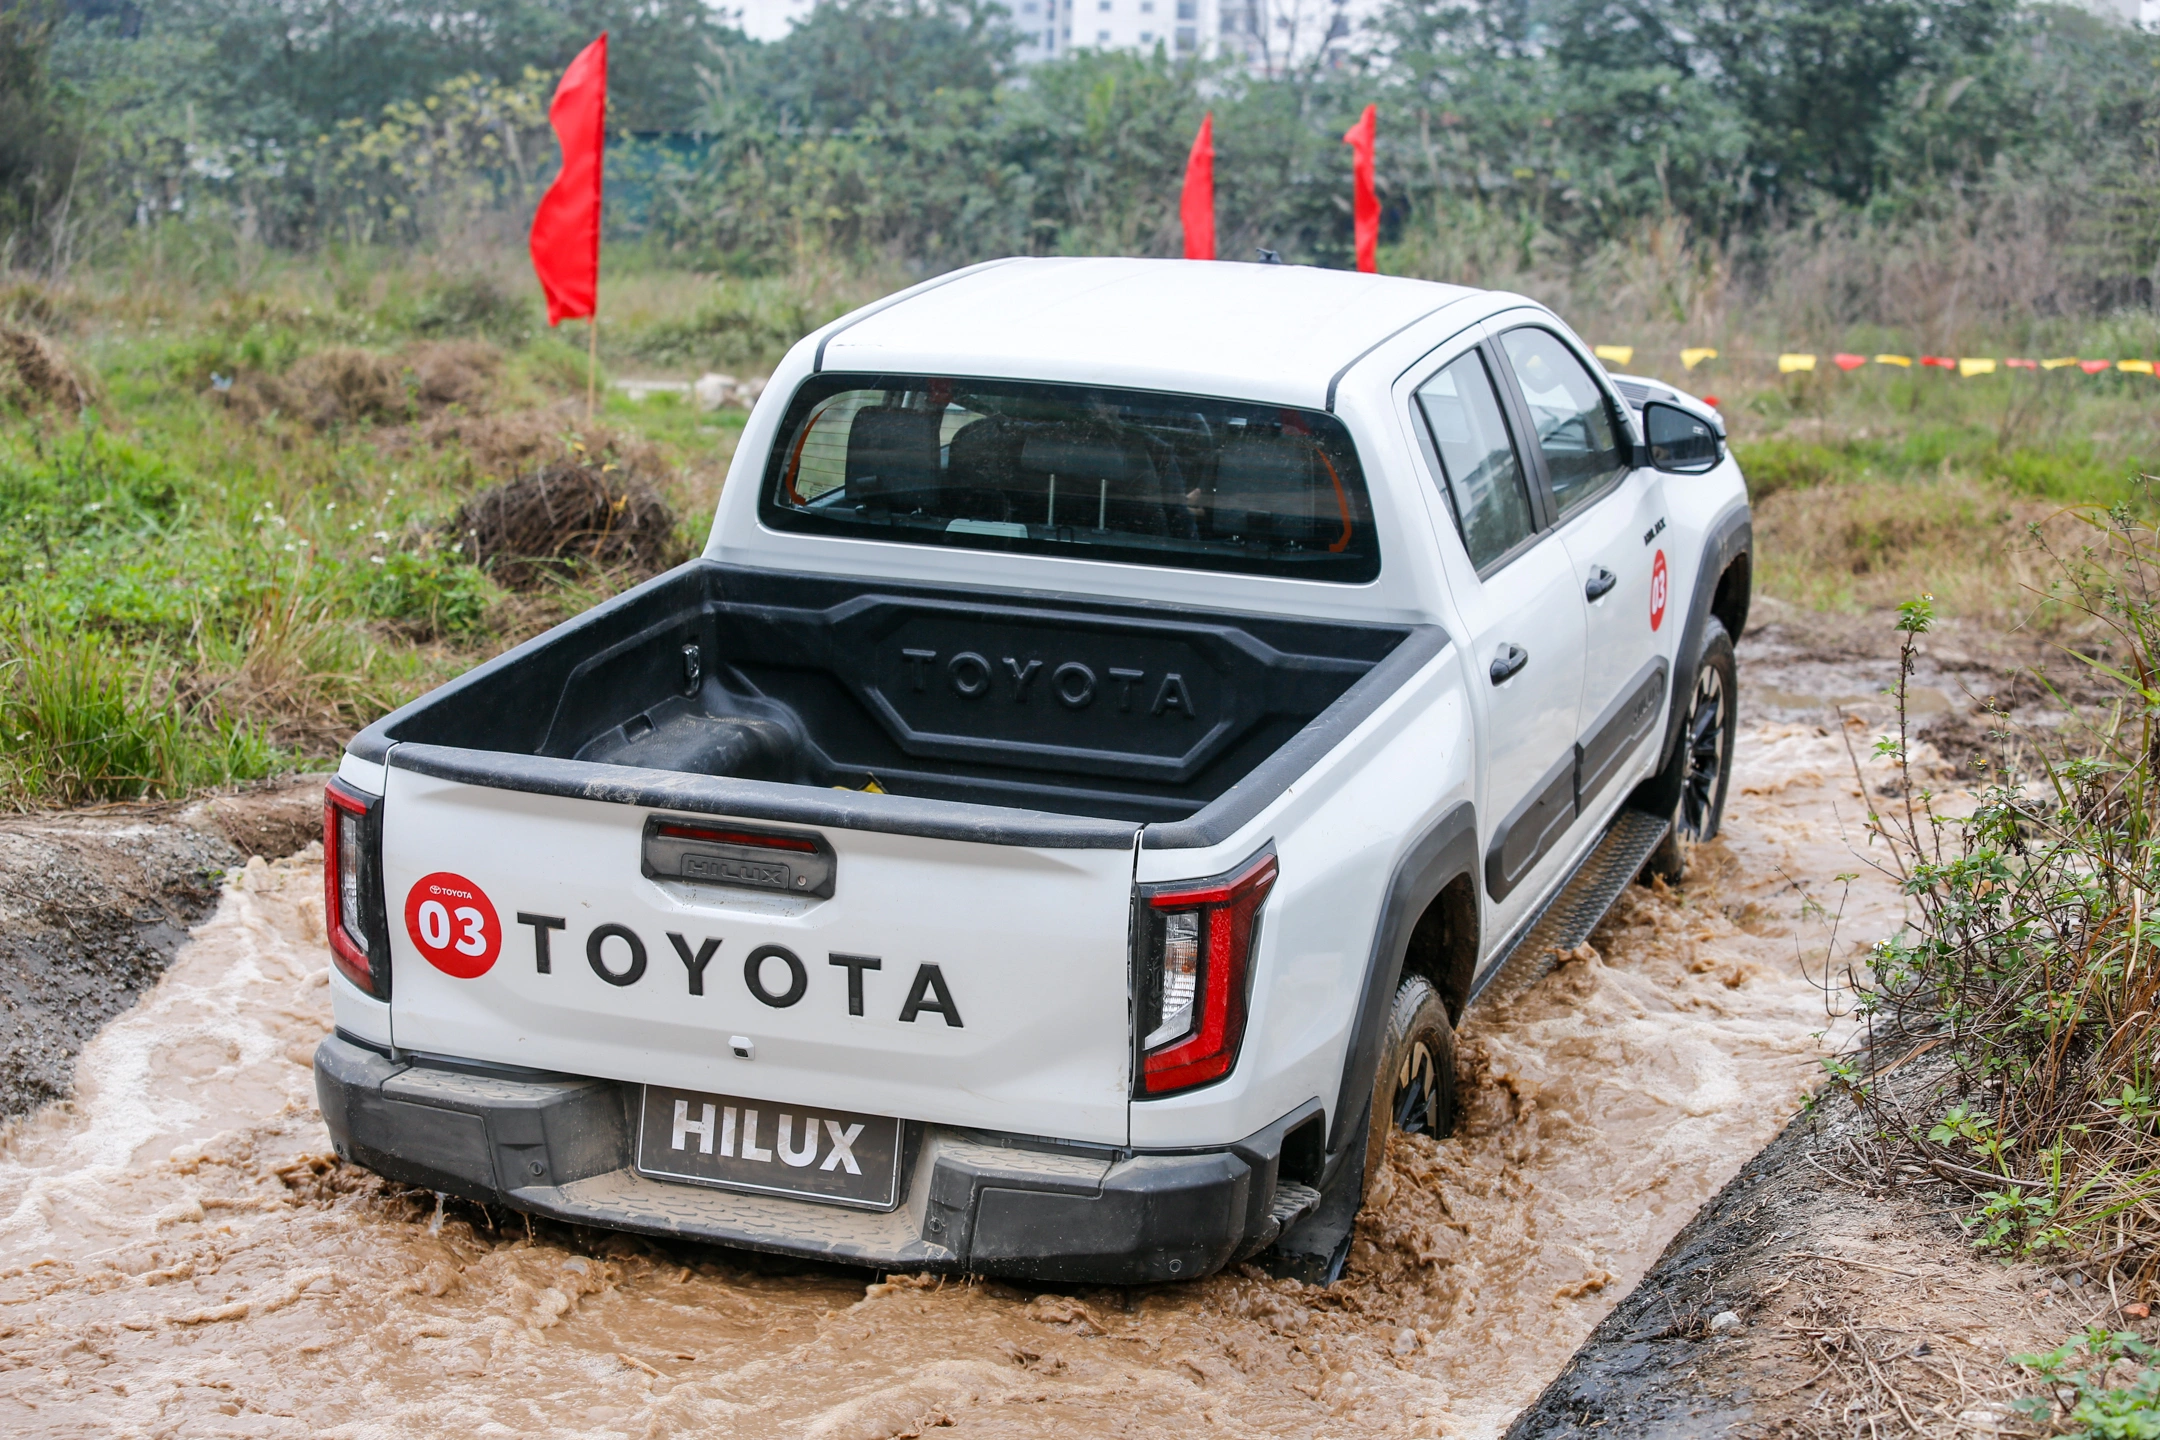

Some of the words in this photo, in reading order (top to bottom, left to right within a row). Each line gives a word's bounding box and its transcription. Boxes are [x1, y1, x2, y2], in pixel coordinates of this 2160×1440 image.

[1652, 569, 1665, 615] 03
[902, 648, 1196, 718] TOYOTA
[441, 887, 473, 900] TOYOTA
[687, 859, 782, 884] HILUX
[418, 899, 488, 957] 03
[516, 911, 965, 1029] TOYOTA
[671, 1099, 866, 1176] HILUX
